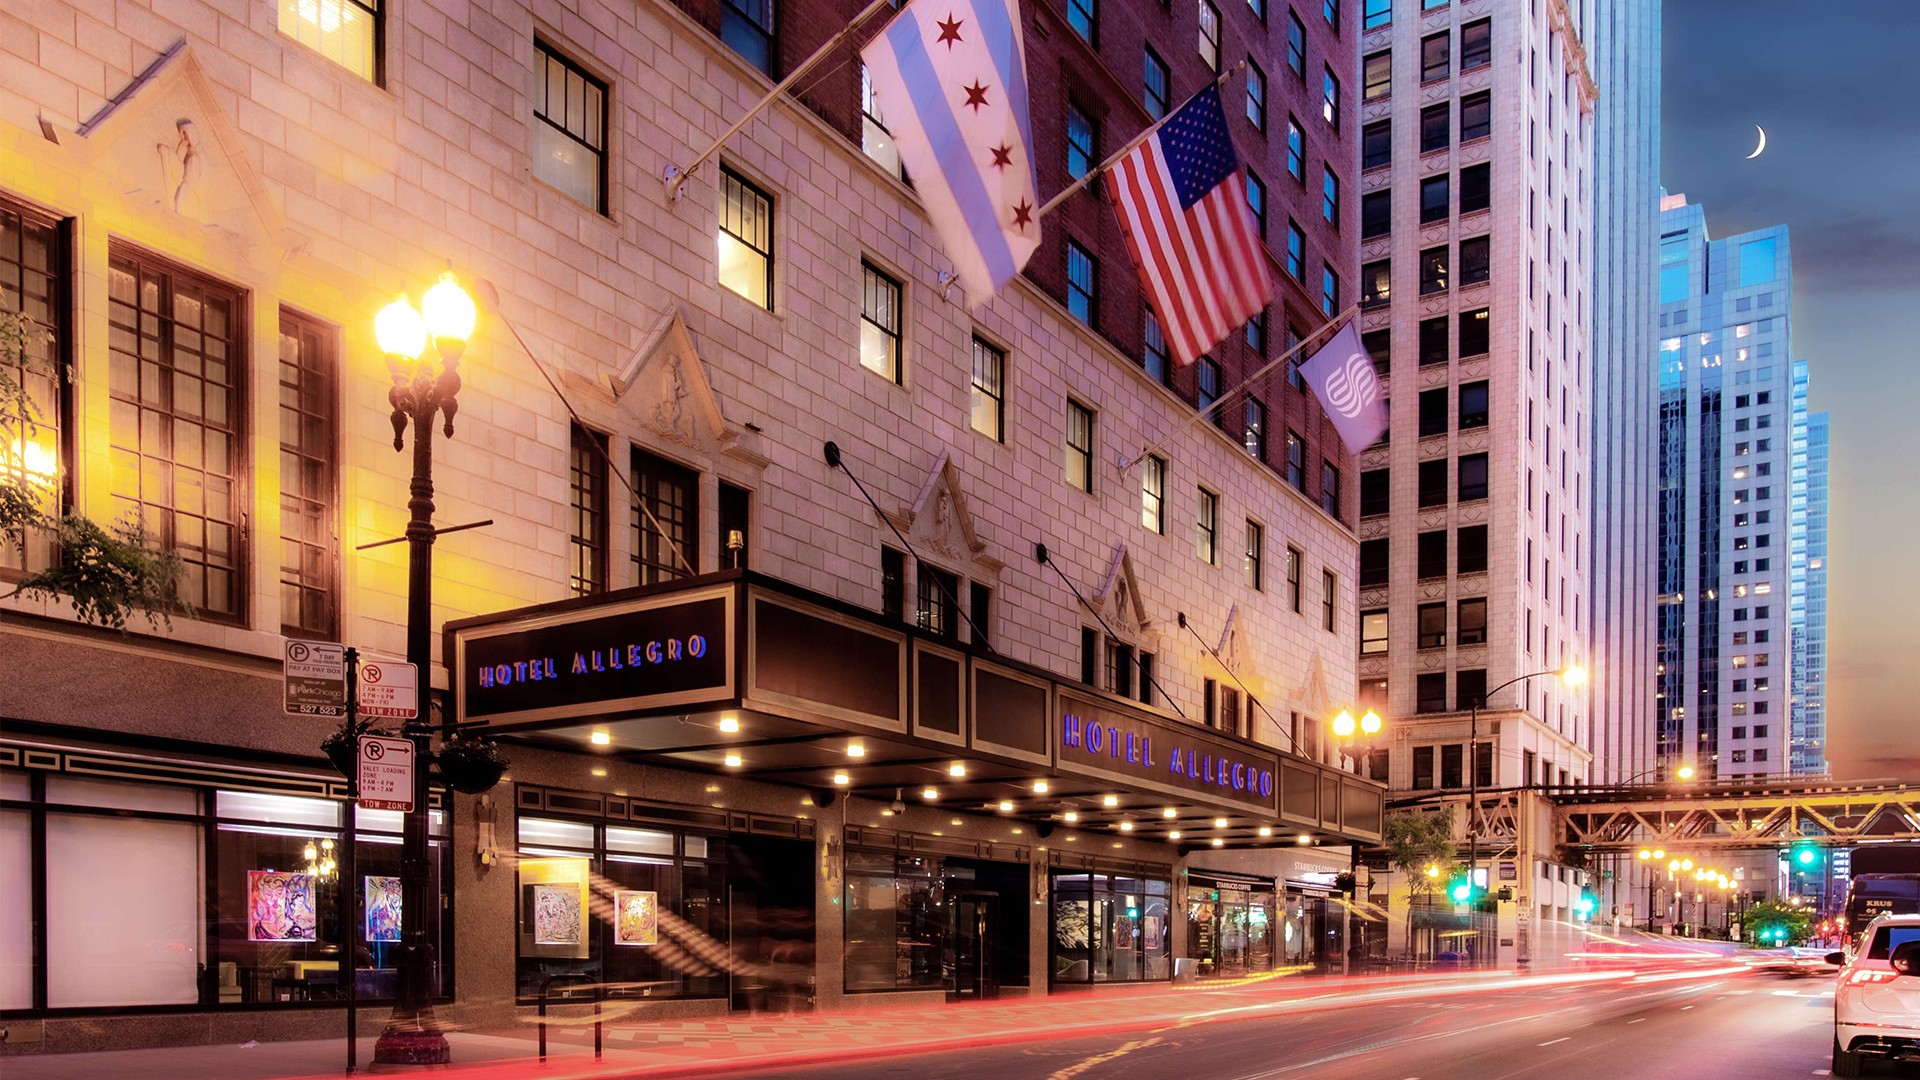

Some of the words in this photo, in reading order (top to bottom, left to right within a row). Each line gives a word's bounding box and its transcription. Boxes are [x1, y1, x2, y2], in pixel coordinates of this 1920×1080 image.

[478, 656, 557, 689] HOTEL
[571, 634, 707, 674] ALLEGRO
[297, 684, 341, 698] ParkChicago
[299, 705, 317, 714] 527
[319, 706, 337, 715] 523
[366, 707, 384, 715] TOW
[387, 709, 410, 717] ZONE
[1063, 713, 1156, 767] HOTEL
[1170, 746, 1273, 798] ALLEGRO
[364, 799, 380, 808] TOW
[387, 801, 407, 810] ZONE
[1294, 861, 1321, 872] STARBUCKS
[1216, 881, 1238, 890] STARBUCKS
